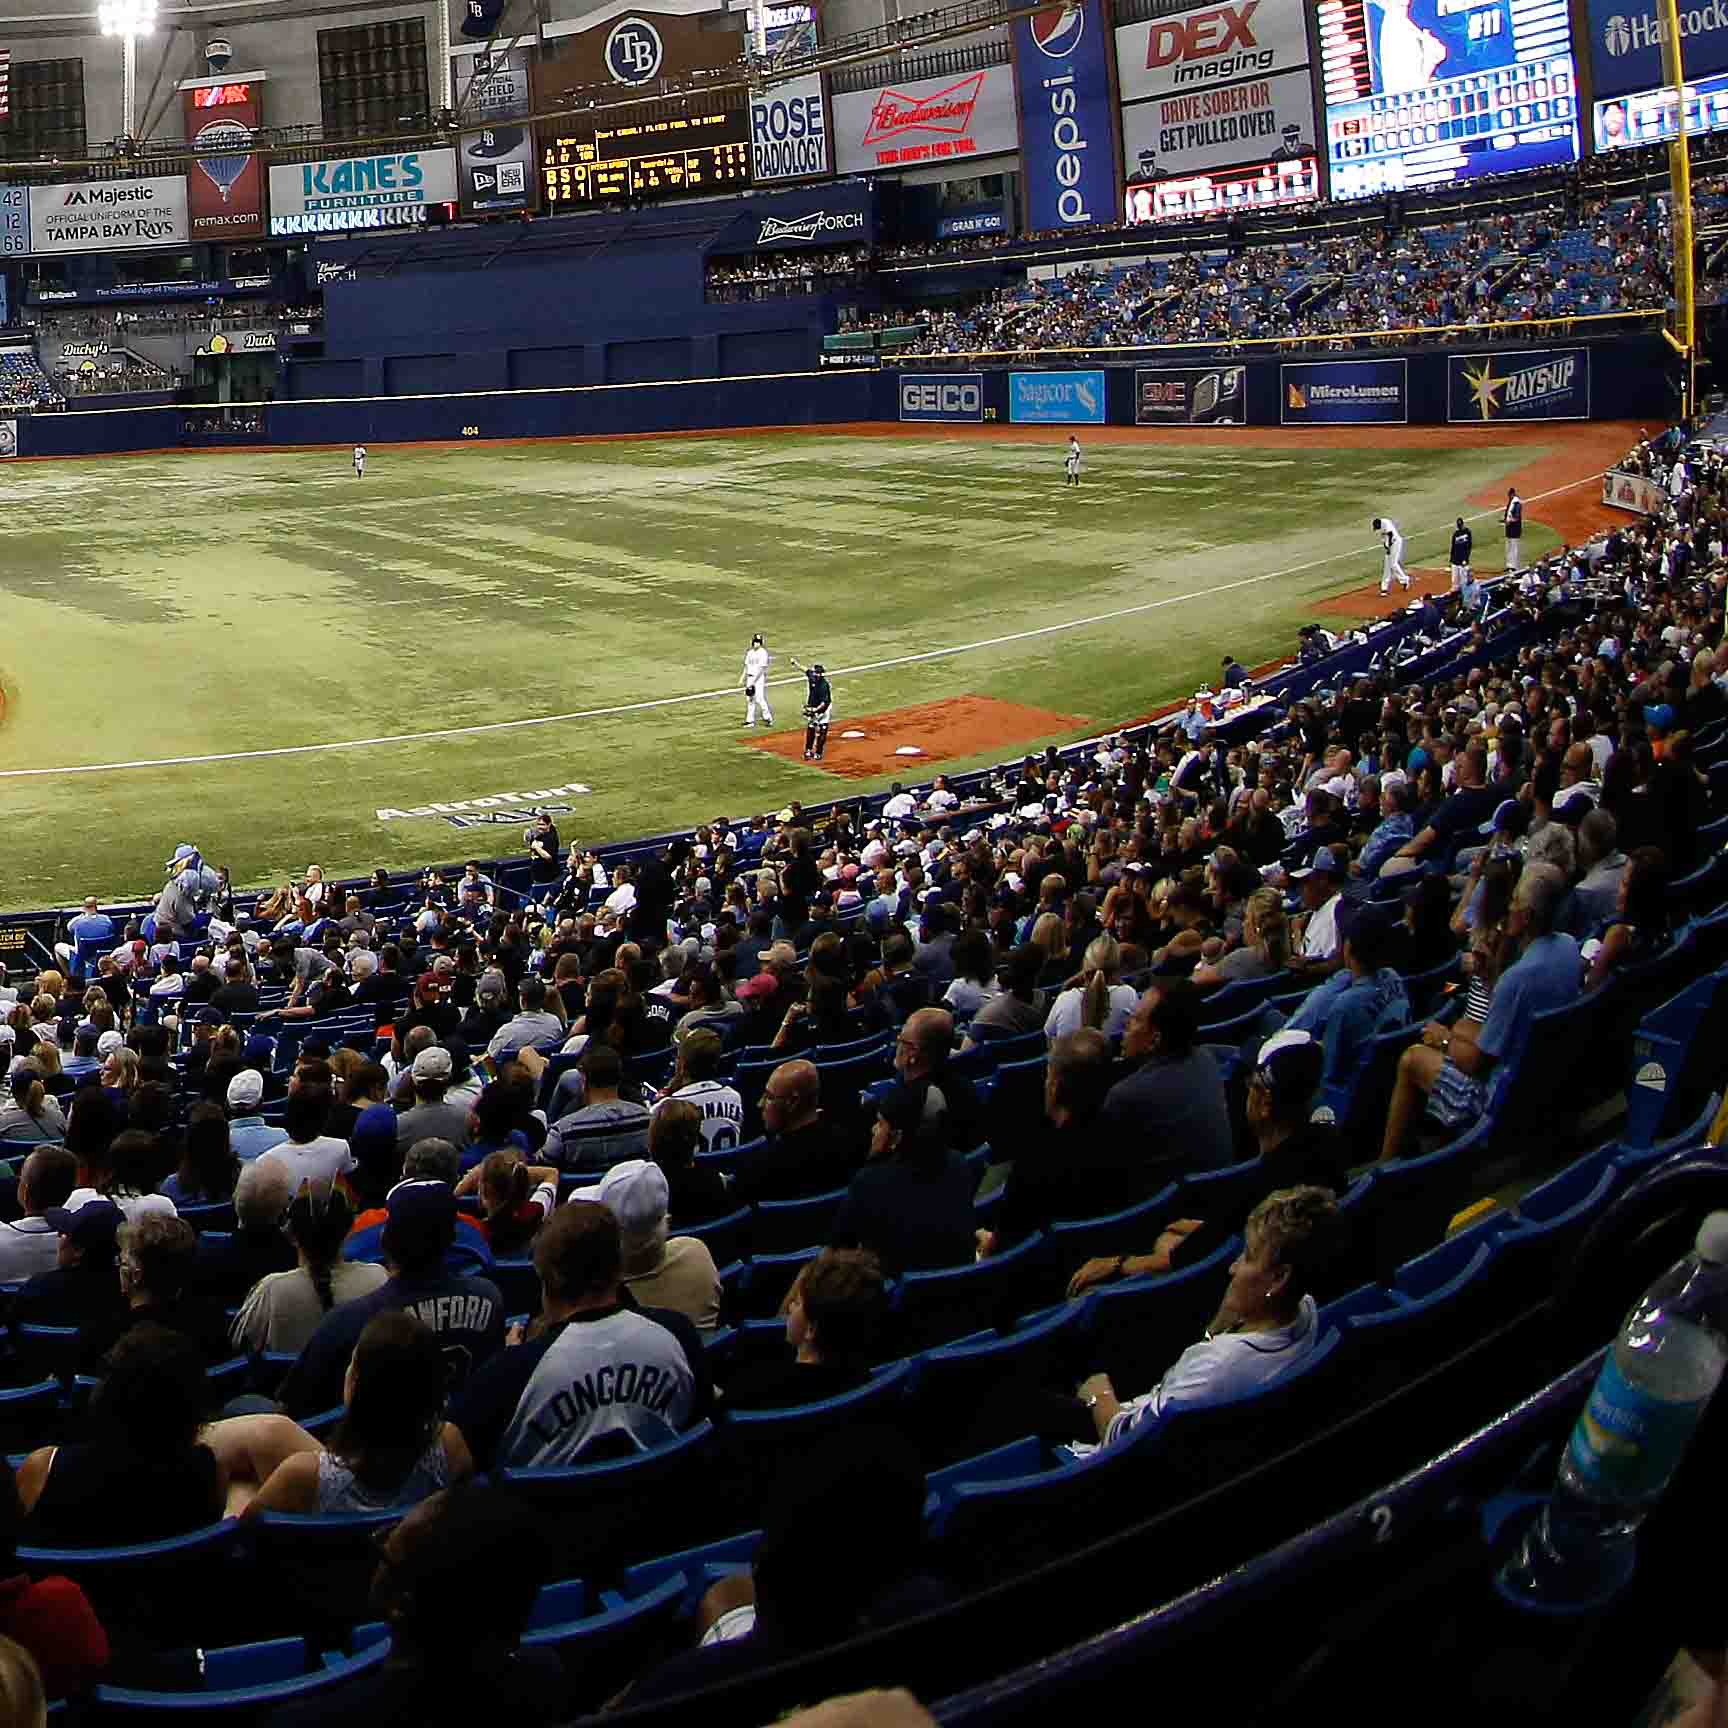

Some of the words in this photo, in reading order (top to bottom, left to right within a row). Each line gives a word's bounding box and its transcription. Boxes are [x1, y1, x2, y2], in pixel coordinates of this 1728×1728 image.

[469, 1, 482, 18] TB
[1146, 0, 1260, 69] DEX
[614, 32, 654, 72] TB
[1174, 49, 1274, 83] imaging
[1160, 96, 1200, 124] DRIVE
[1203, 88, 1248, 118] SOBER
[1250, 82, 1272, 108] OR
[751, 95, 823, 143] ROSE
[873, 99, 976, 129] Budweiser
[1160, 126, 1186, 152] GET
[1187, 116, 1239, 148] PULLED
[1240, 110, 1276, 138] OVER
[755, 137, 824, 178] RADIOLOGY
[1044, 74, 1092, 223] pepsi
[304, 154, 423, 196] KANE'S
[501, 168, 520, 180] NEW
[502, 178, 521, 188] ERA
[546, 170, 556, 184] B
[560, 168, 570, 183] S
[2, 191, 22, 207] 42
[89, 186, 153, 206] Majestic
[308, 191, 417, 210] FURNITURE
[548, 186, 556, 200] 0
[561, 184, 570, 199] 2
[577, 182, 585, 196] 1
[5, 213, 20, 228] 12
[46, 213, 91, 224] OFFICIAL
[92, 210, 135, 222] UNIFORM
[137, 208, 151, 218] OF
[153, 207, 172, 217] THE
[194, 212, 258, 227] remax.com
[46, 226, 98, 241] TAMPA
[103, 223, 133, 238] BAY
[763, 218, 820, 238] Budweiser
[817, 213, 863, 230] PORCH
[952, 219, 974, 232] GRAB
[4, 235, 24, 251] 66
[63, 340, 108, 357] Ducky's
[246, 334, 276, 348] Duck
[1018, 376, 1073, 409] Sagicor
[1143, 382, 1185, 400] GMC
[1310, 384, 1399, 401] MicroLumen
[1506, 367, 1546, 402] RAYS
[902, 384, 980, 412] GEICO
[462, 425, 479, 436] 404
[376, 783, 593, 820] AstroTurf
[528, 1363, 681, 1444] LONGORIA
